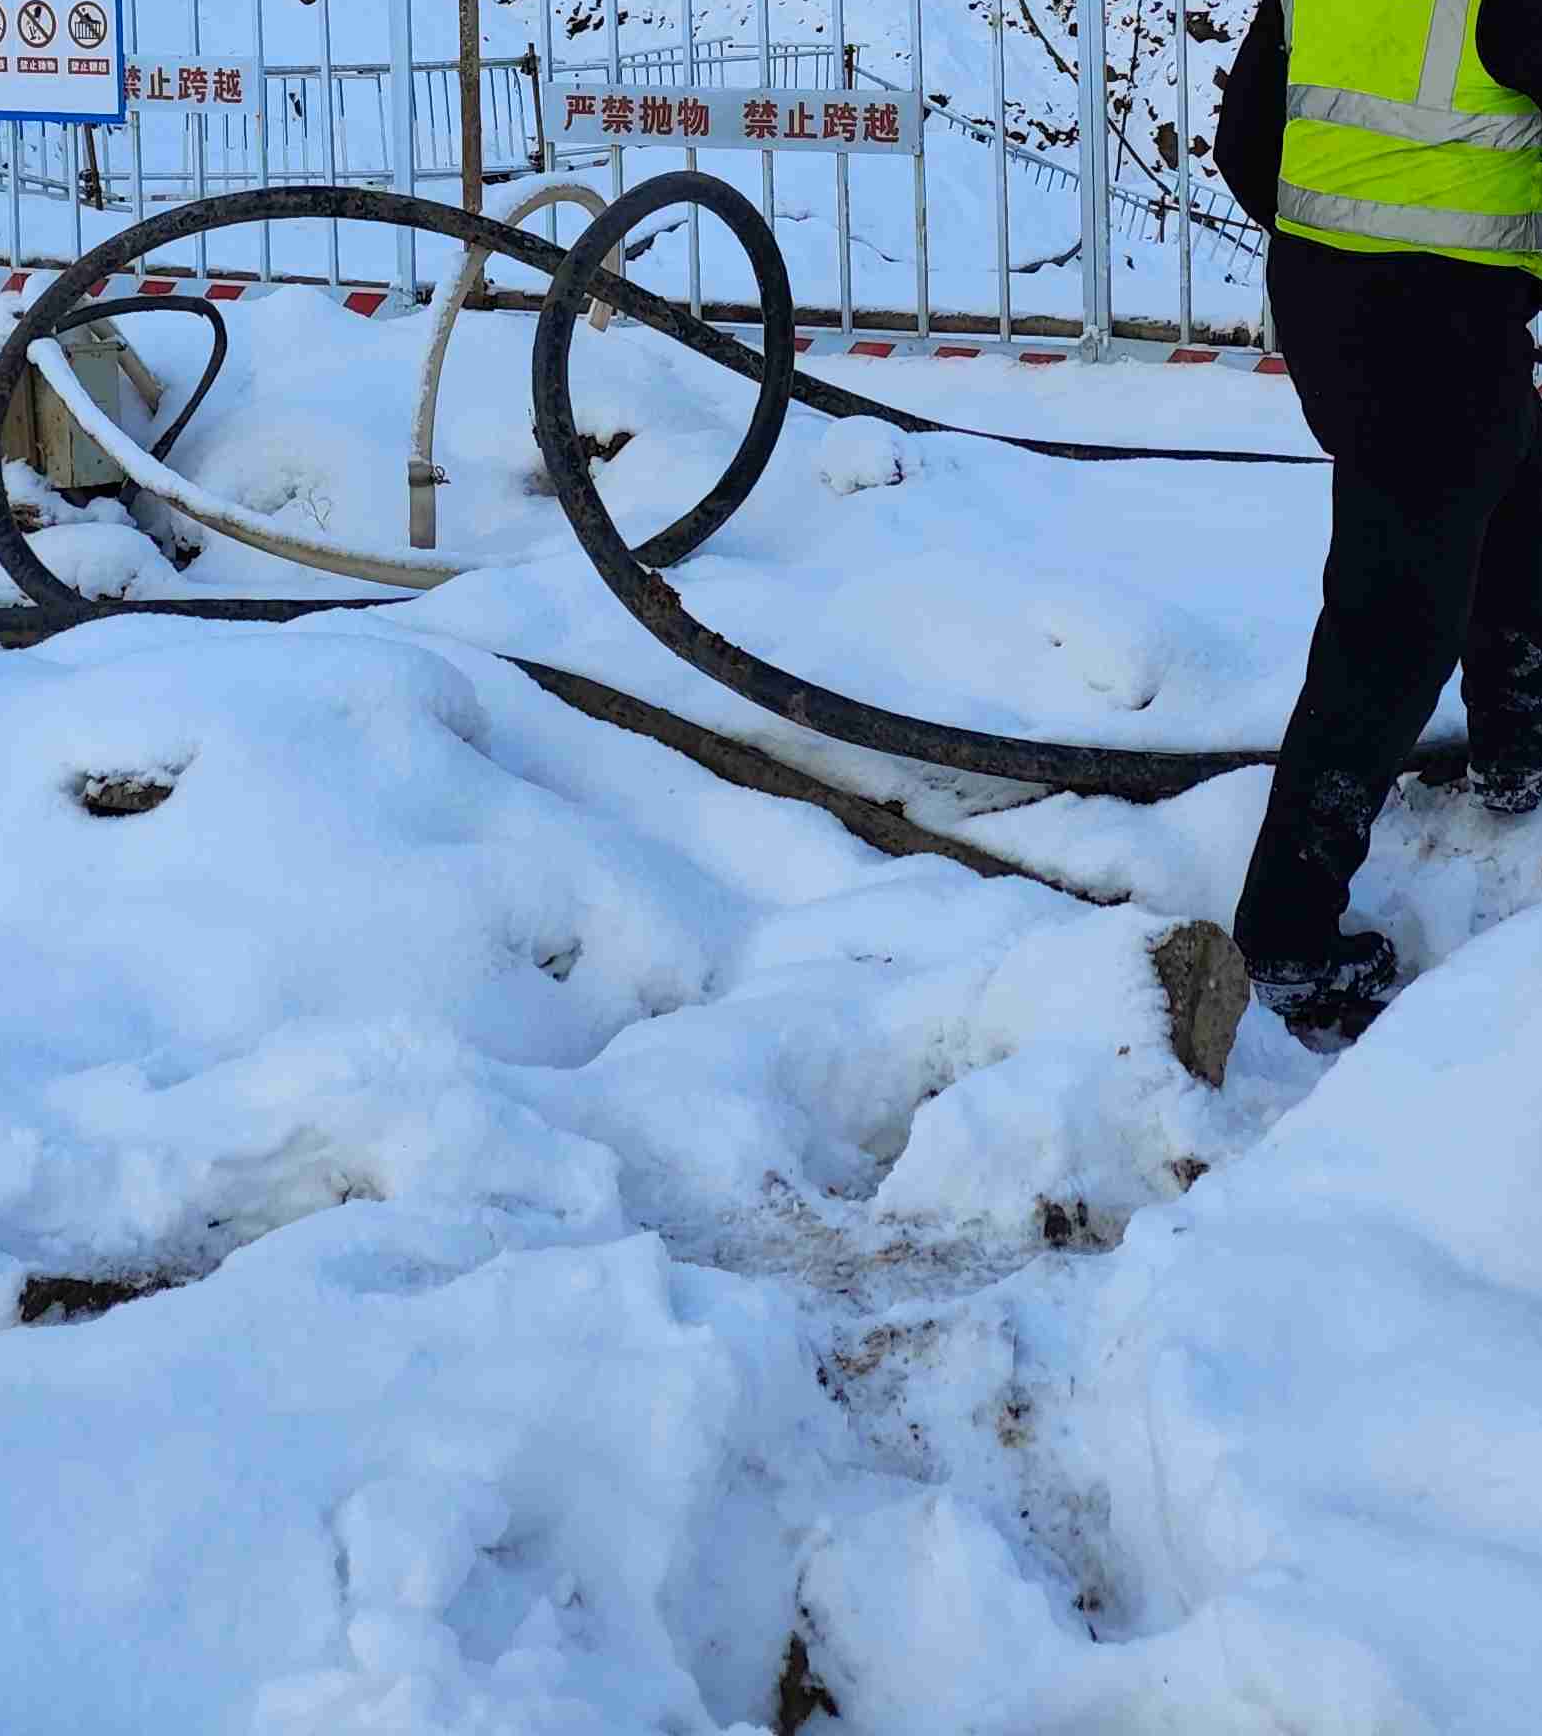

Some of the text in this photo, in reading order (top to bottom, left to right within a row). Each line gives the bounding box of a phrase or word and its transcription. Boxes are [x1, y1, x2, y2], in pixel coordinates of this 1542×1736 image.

[564, 94, 900, 143] 严禁抛物 禁止跨越
